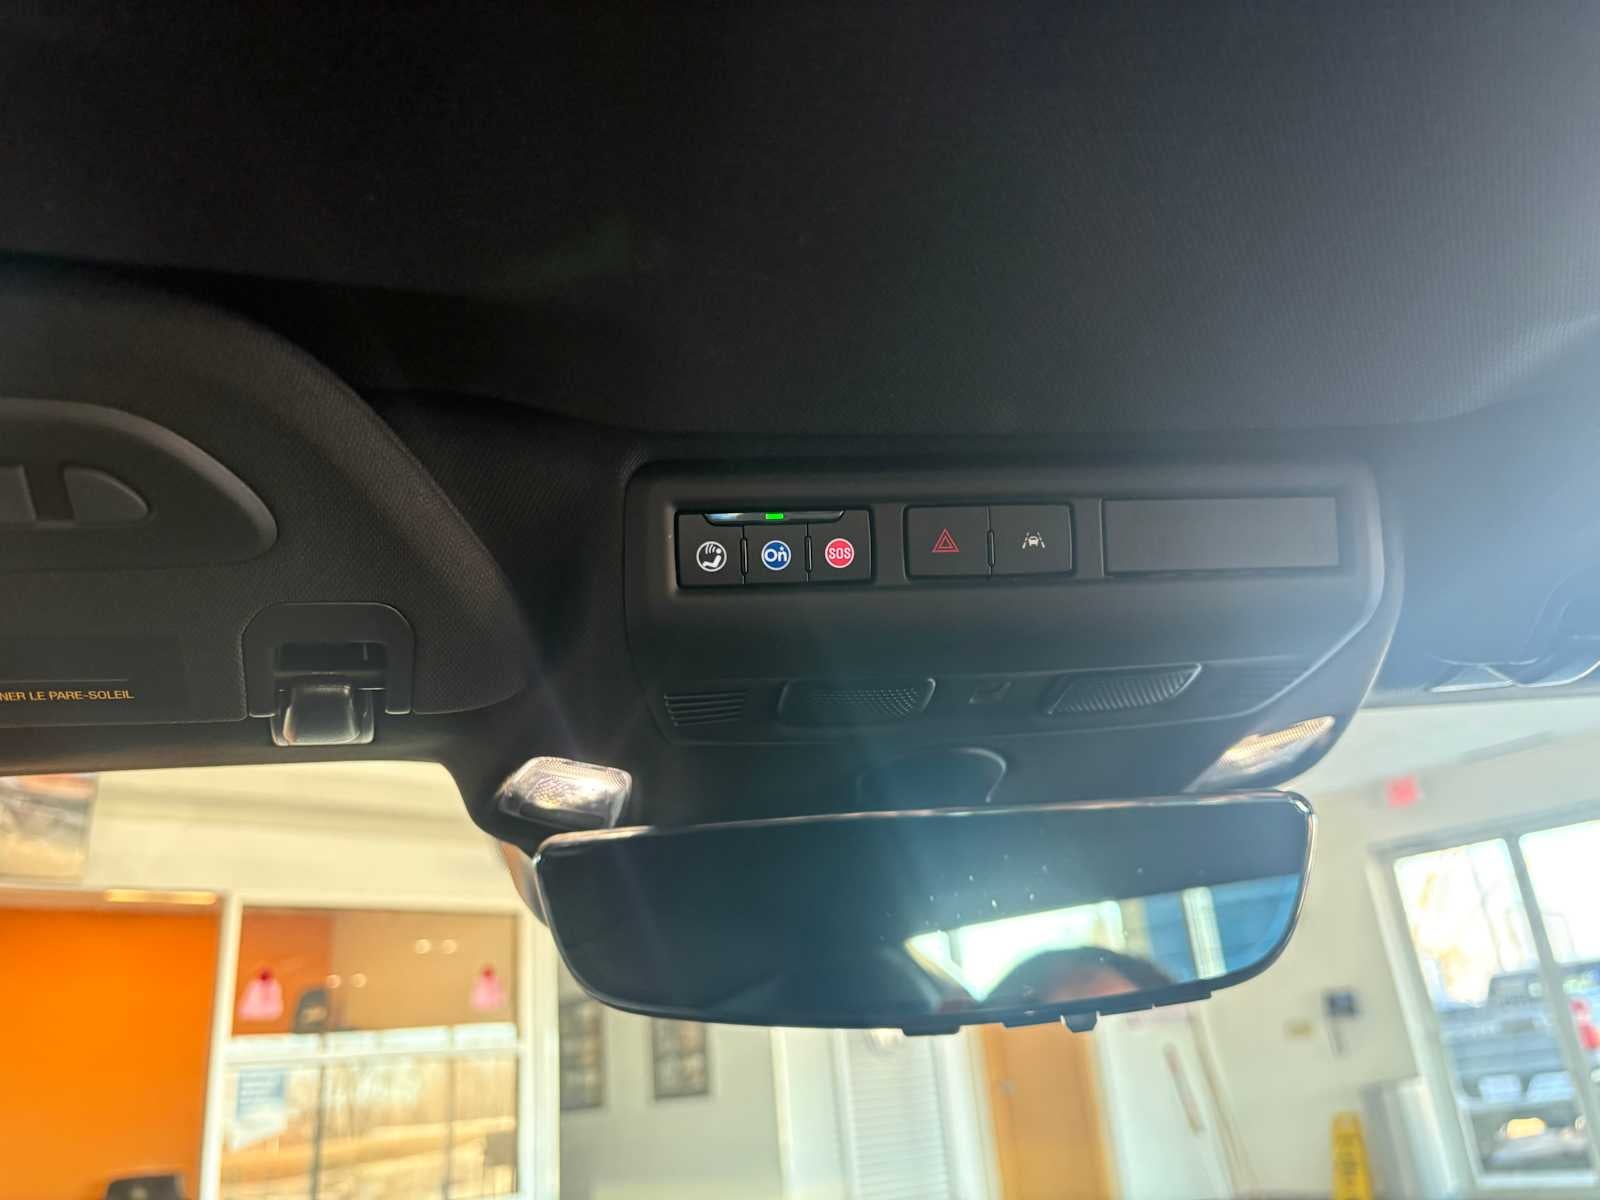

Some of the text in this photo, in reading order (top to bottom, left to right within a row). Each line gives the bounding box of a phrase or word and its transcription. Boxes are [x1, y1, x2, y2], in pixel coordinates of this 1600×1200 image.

[829, 547, 851, 560] SOS
[29, 690, 47, 701] LE
[49, 690, 135, 701] PARE-SOLEIL
